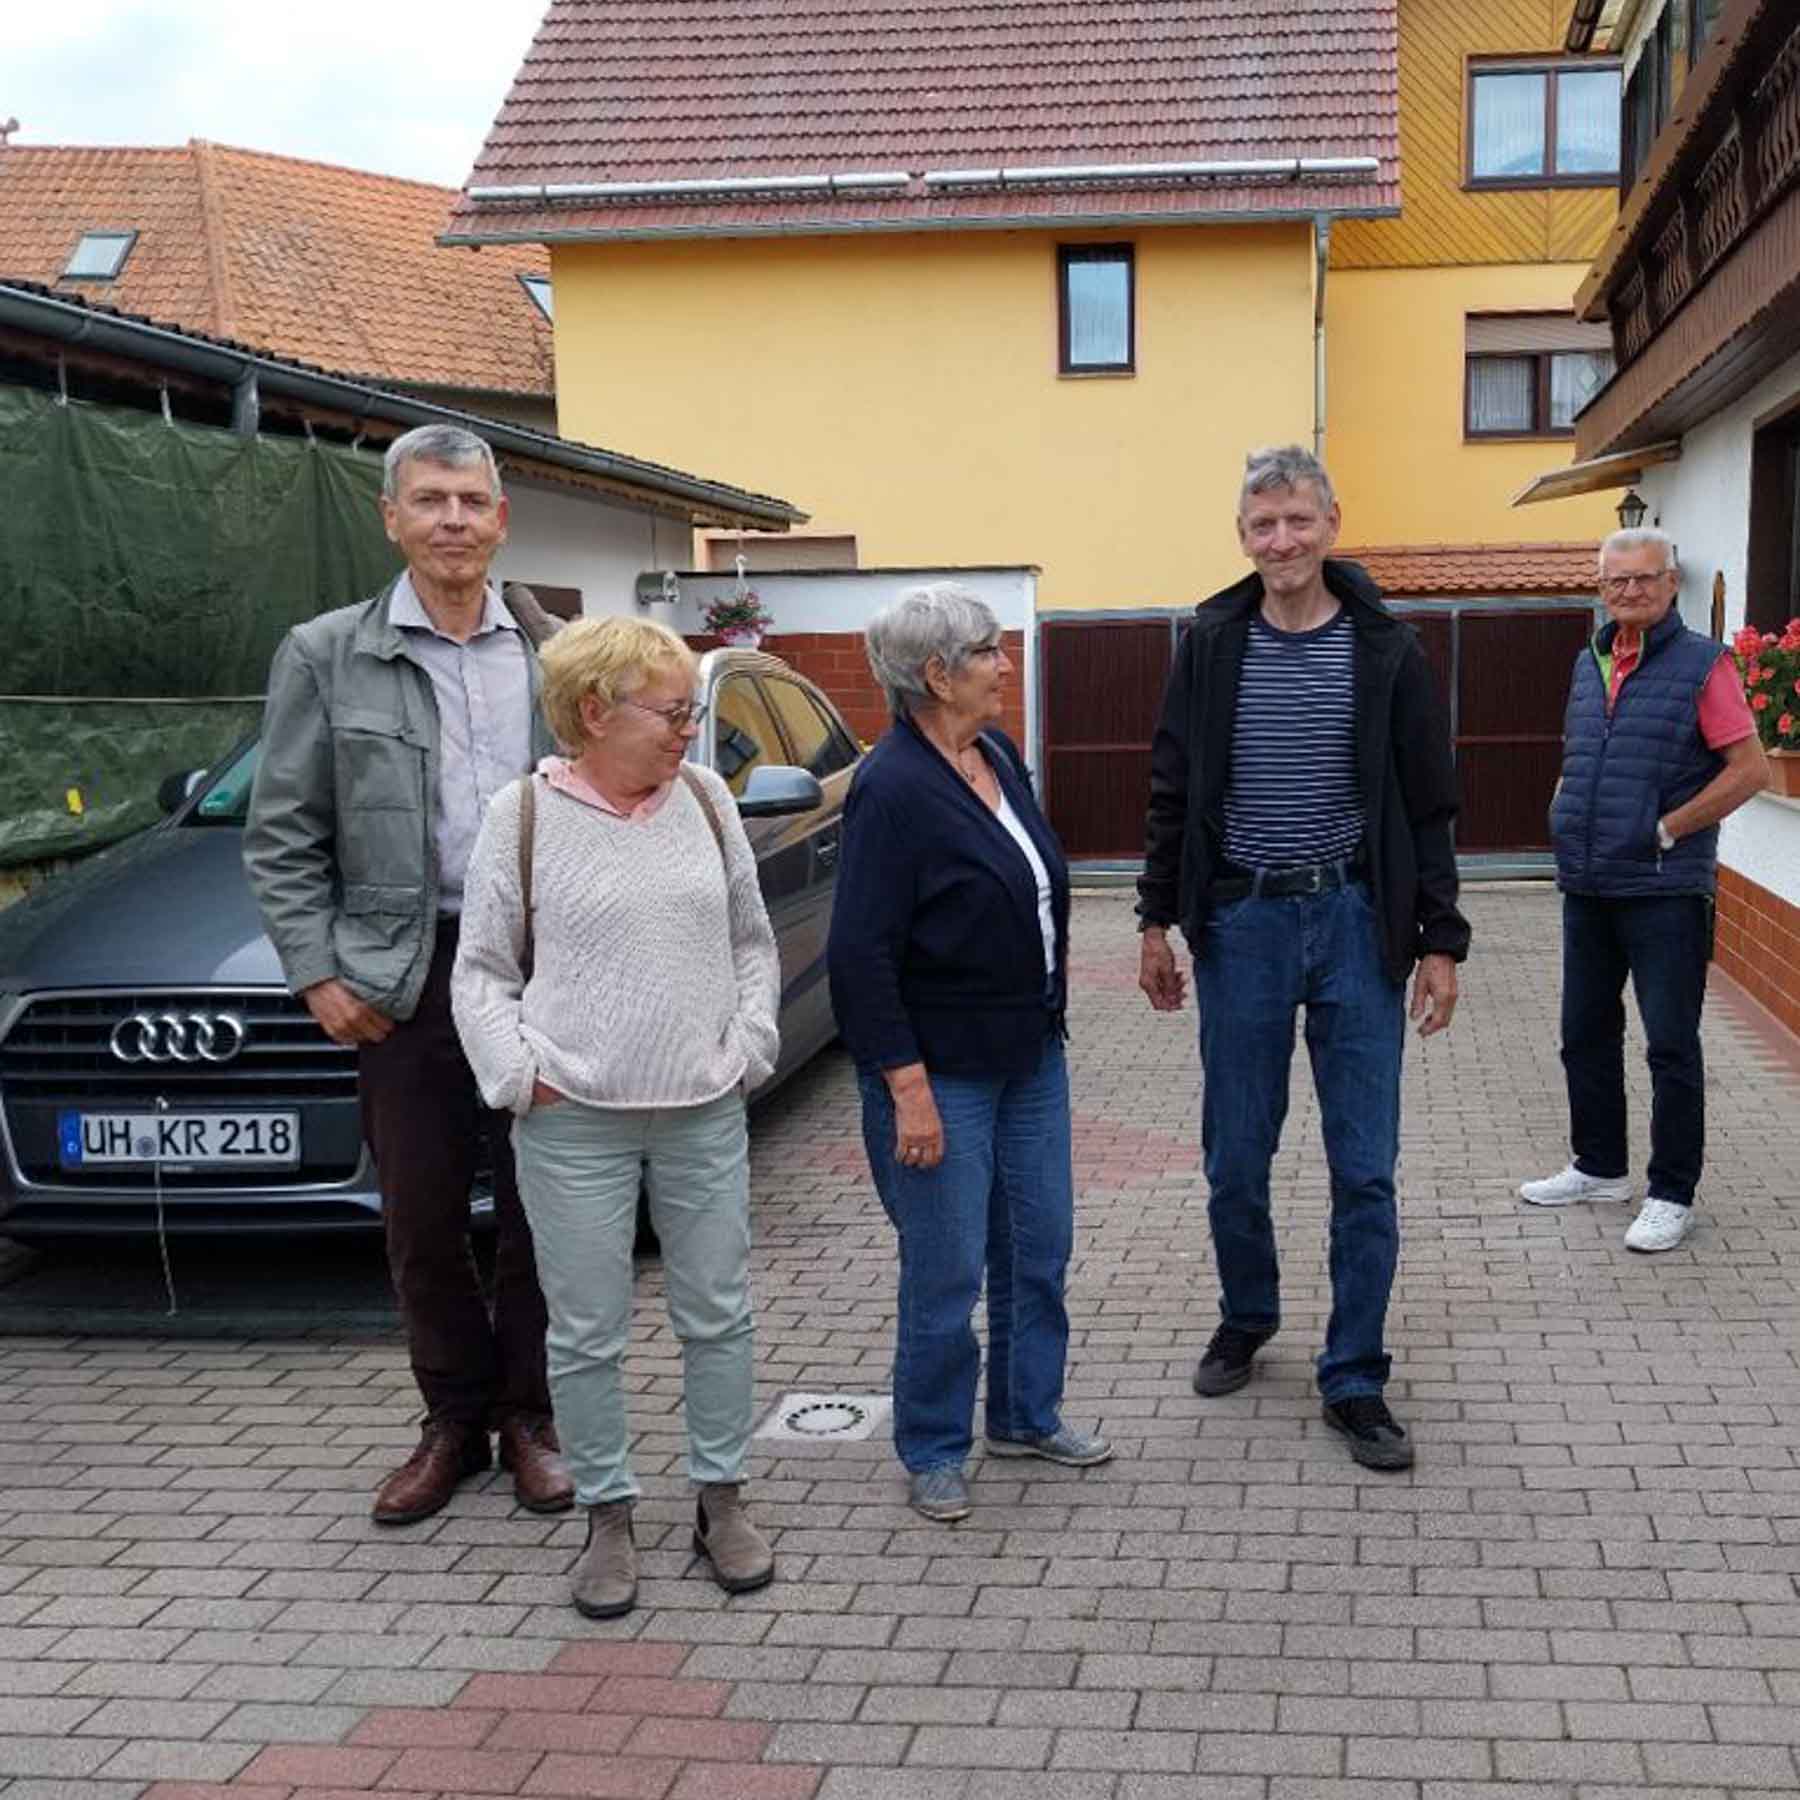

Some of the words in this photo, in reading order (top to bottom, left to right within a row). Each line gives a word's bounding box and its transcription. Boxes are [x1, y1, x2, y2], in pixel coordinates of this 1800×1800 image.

[84, 1119, 132, 1154] UH
[158, 1119, 209, 1155] KR
[219, 1119, 290, 1154] 218
